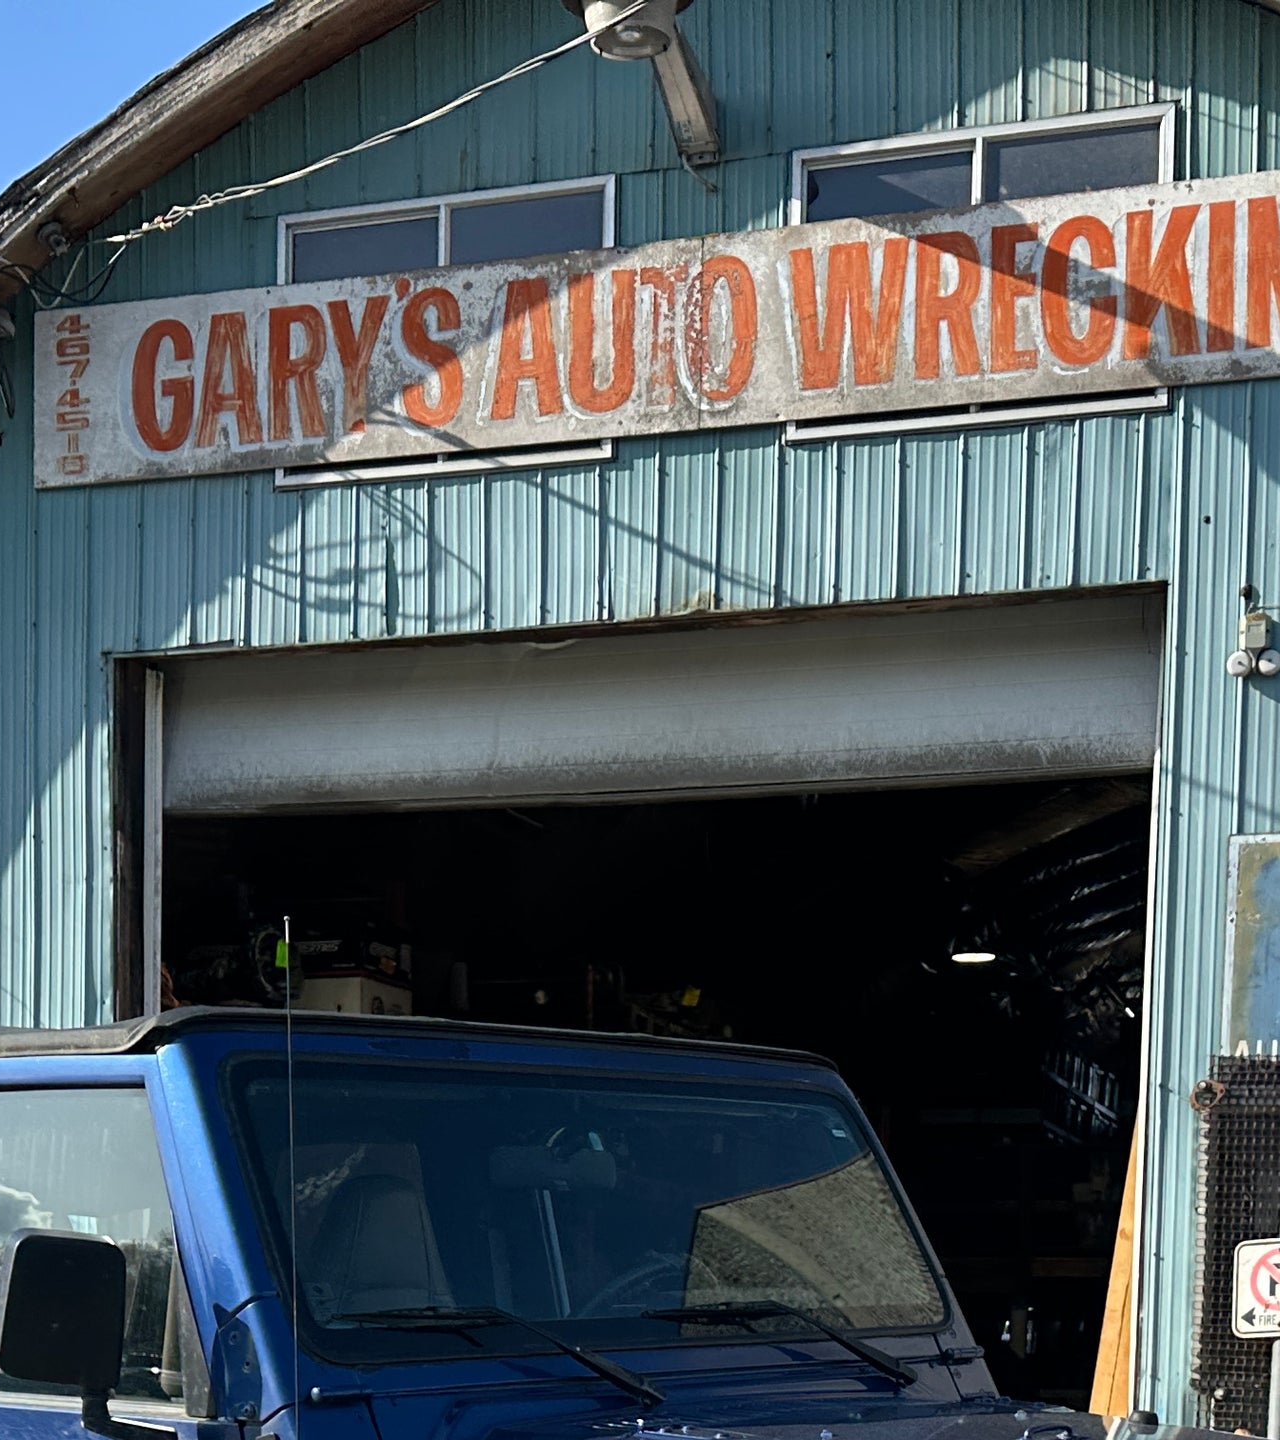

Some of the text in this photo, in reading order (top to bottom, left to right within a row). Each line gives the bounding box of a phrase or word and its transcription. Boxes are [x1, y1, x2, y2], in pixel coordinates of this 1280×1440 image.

[131, 277, 463, 452] GARY'S
[489, 255, 758, 421] AUTO
[1259, 1314, 1277, 1326] FIRE
